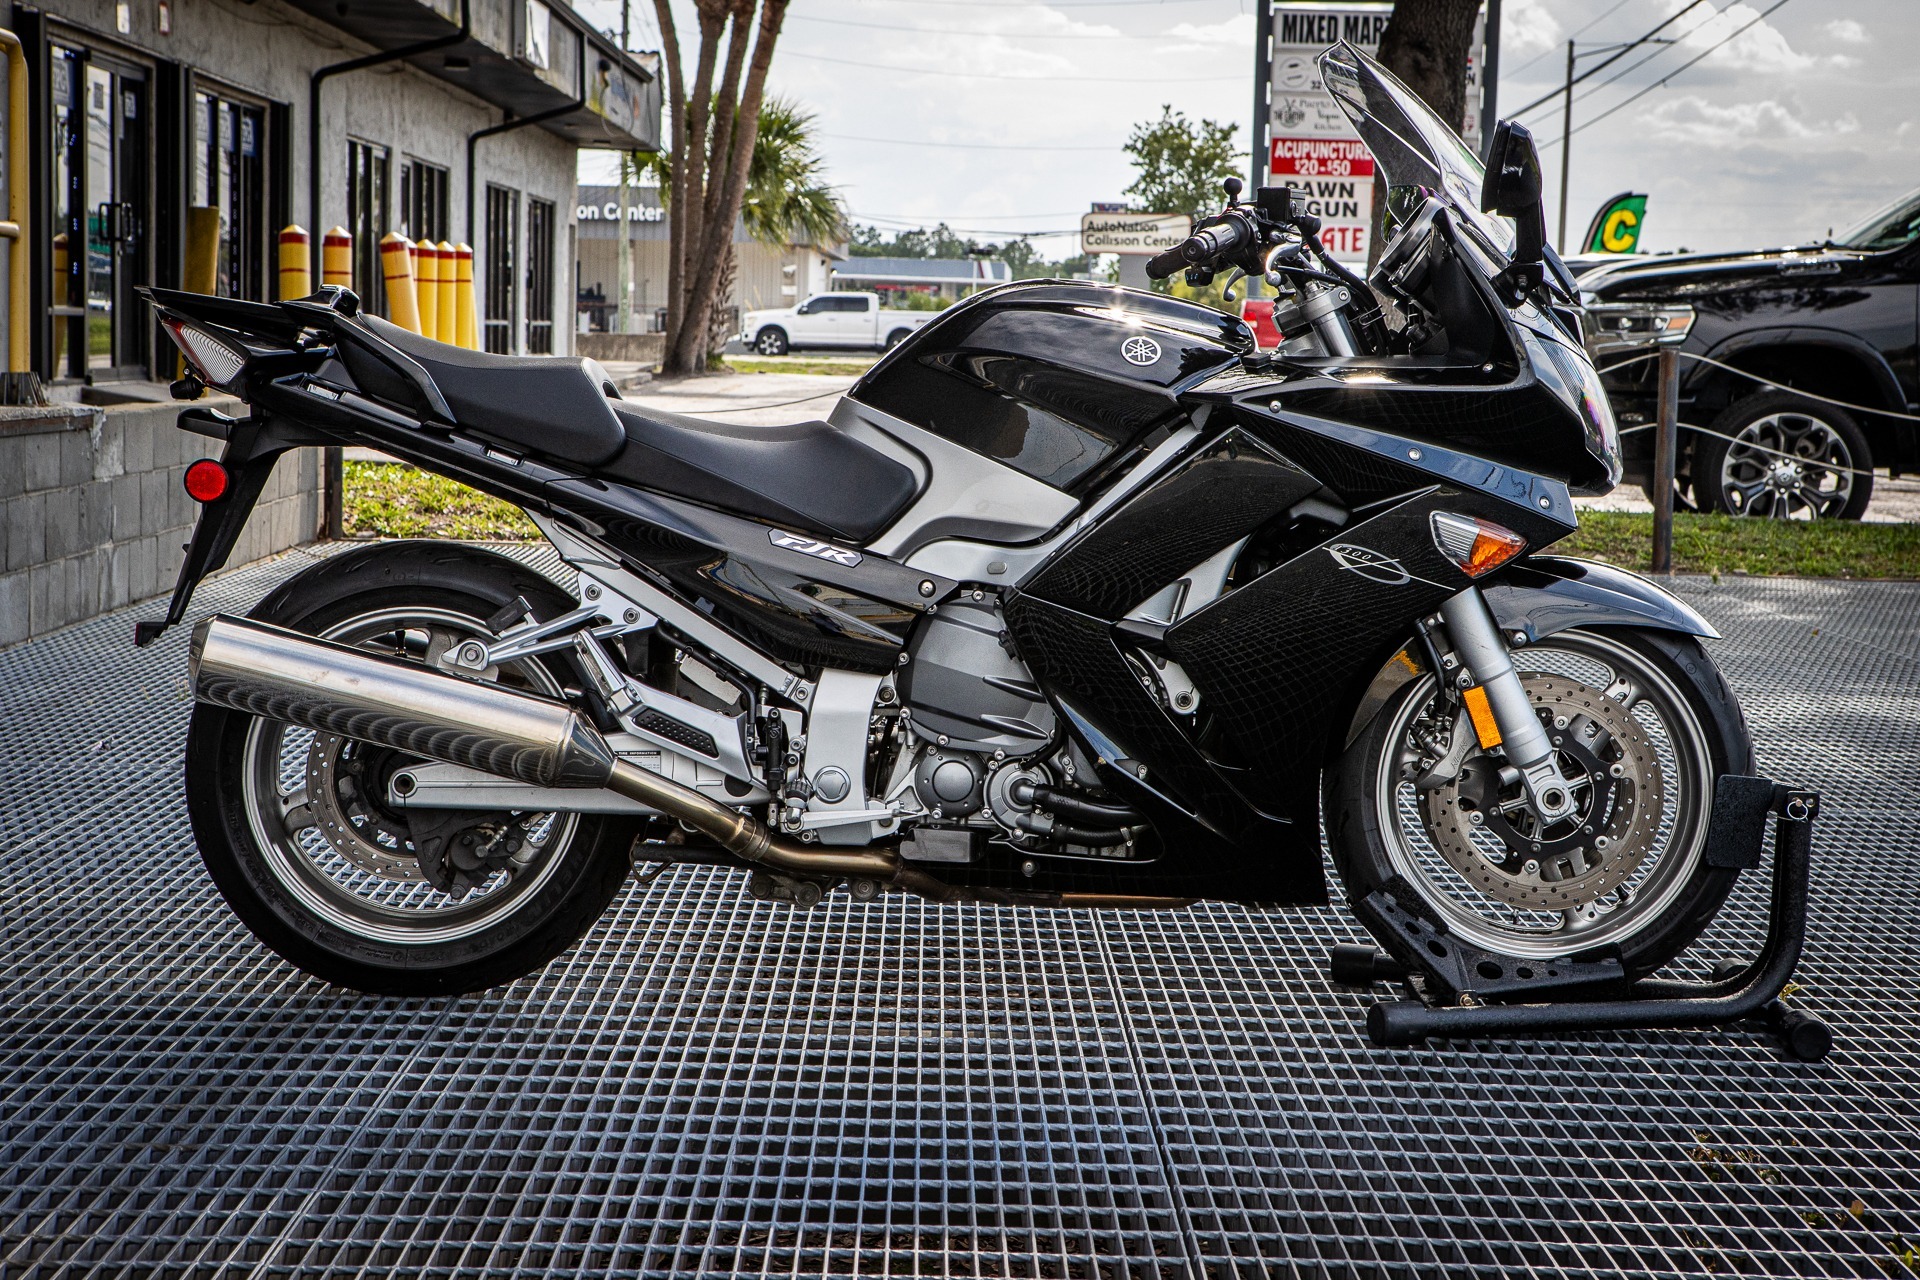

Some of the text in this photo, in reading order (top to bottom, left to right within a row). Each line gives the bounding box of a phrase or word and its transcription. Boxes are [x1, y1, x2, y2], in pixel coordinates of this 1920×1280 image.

[1282, 13, 1390, 44] MIXED MAR
[1294, 159, 1351, 176] $20-$50
[576, 204, 600, 220] on
[1087, 220, 1159, 232] AutoNation
[1602, 208, 1637, 252] C
[1086, 234, 1140, 246] Collision
[1321, 227, 1364, 251] ATE
[774, 533, 857, 564] FJR
[1335, 544, 1372, 560] 1300
